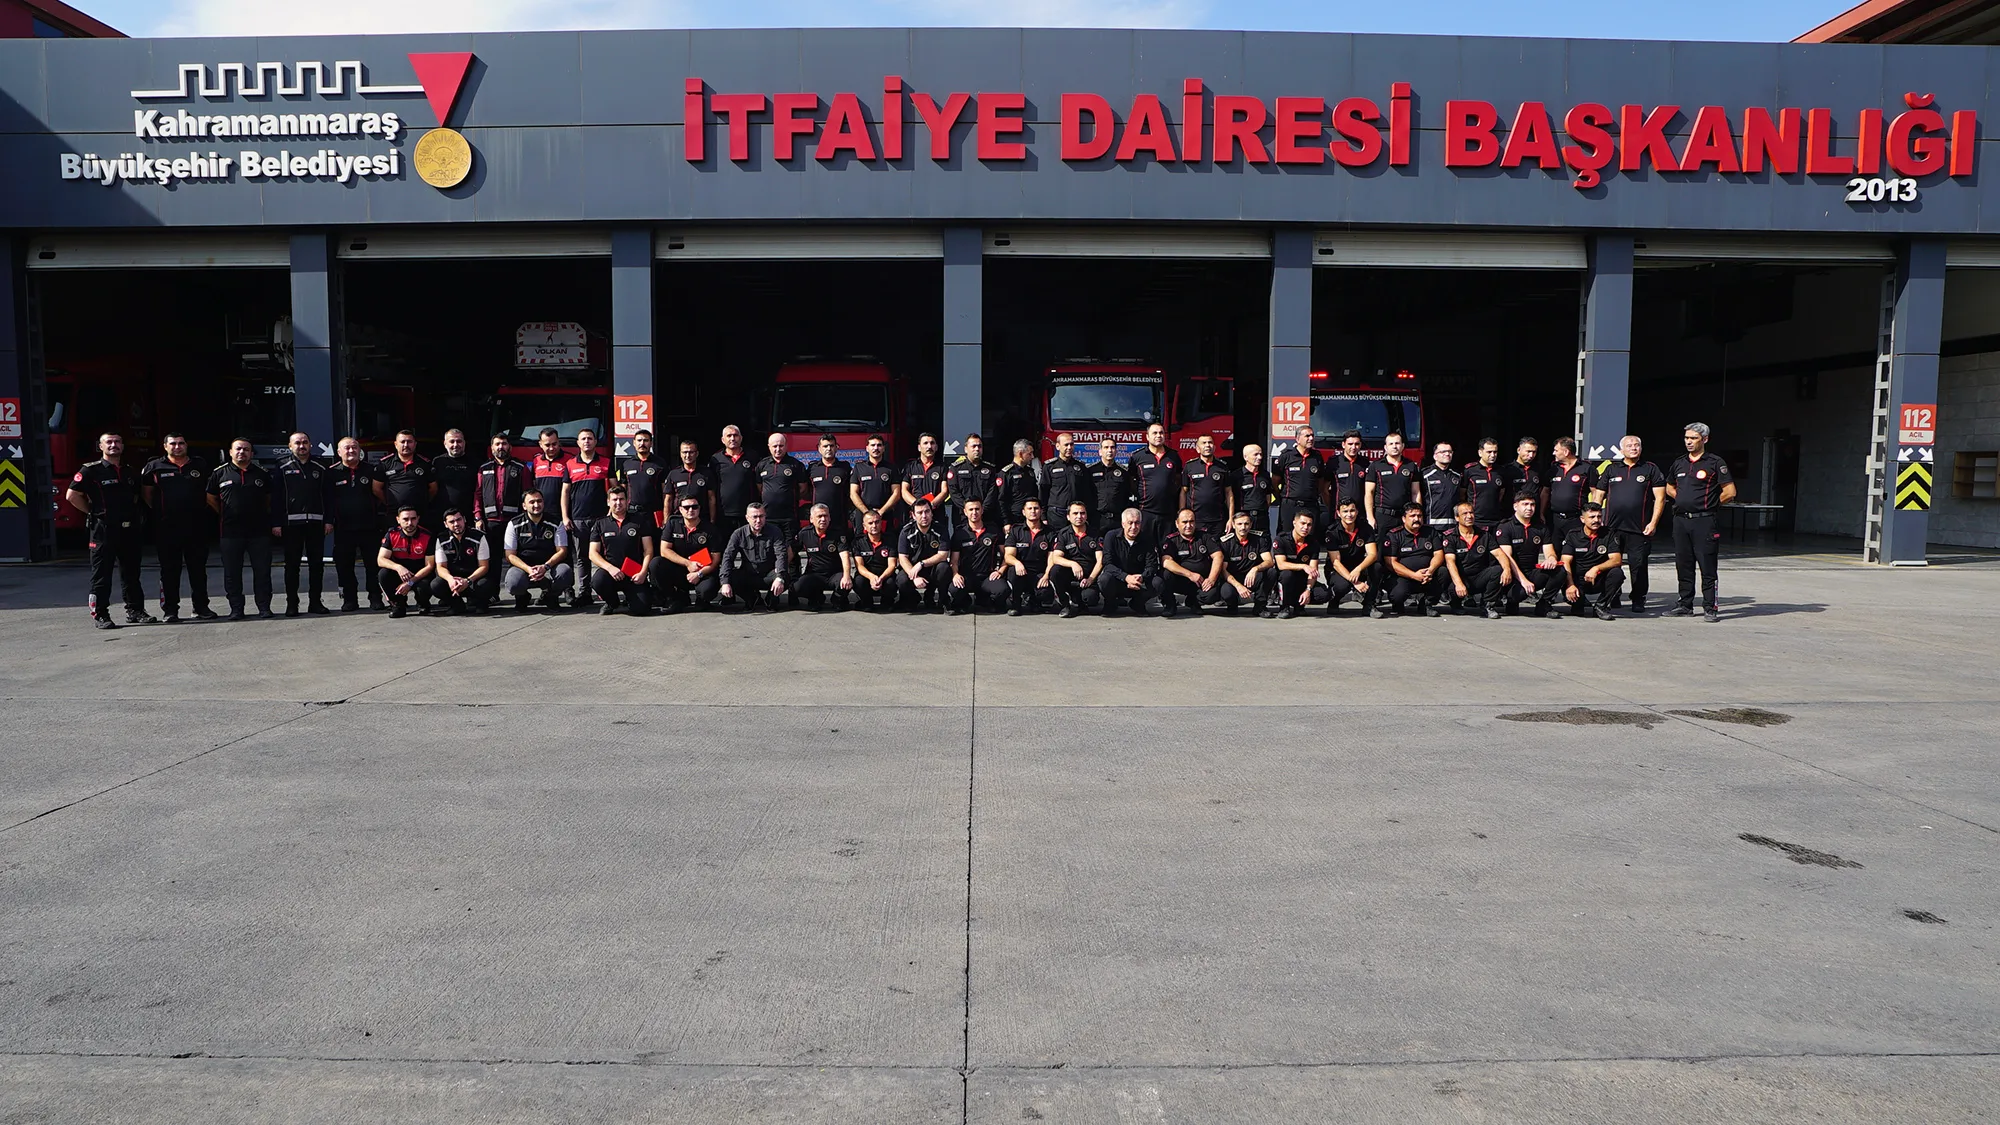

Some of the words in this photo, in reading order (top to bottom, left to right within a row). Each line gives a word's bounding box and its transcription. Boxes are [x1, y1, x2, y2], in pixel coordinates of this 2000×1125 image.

[134, 109, 400, 141] Kahramanmaraş
[684, 75, 1026, 161] İTFAİYE
[1060, 77, 1412, 165] DAİRESİ
[1445, 91, 1977, 188] BAŞKANLIĞI
[60, 151, 233, 185] Büyükşehir
[240, 149, 399, 183] Belediyesi
[1846, 178, 1918, 202] 2013
[0, 402, 17, 421] 12
[618, 399, 649, 420] 112
[1276, 401, 1306, 422] 112
[1904, 409, 1931, 428] 112
